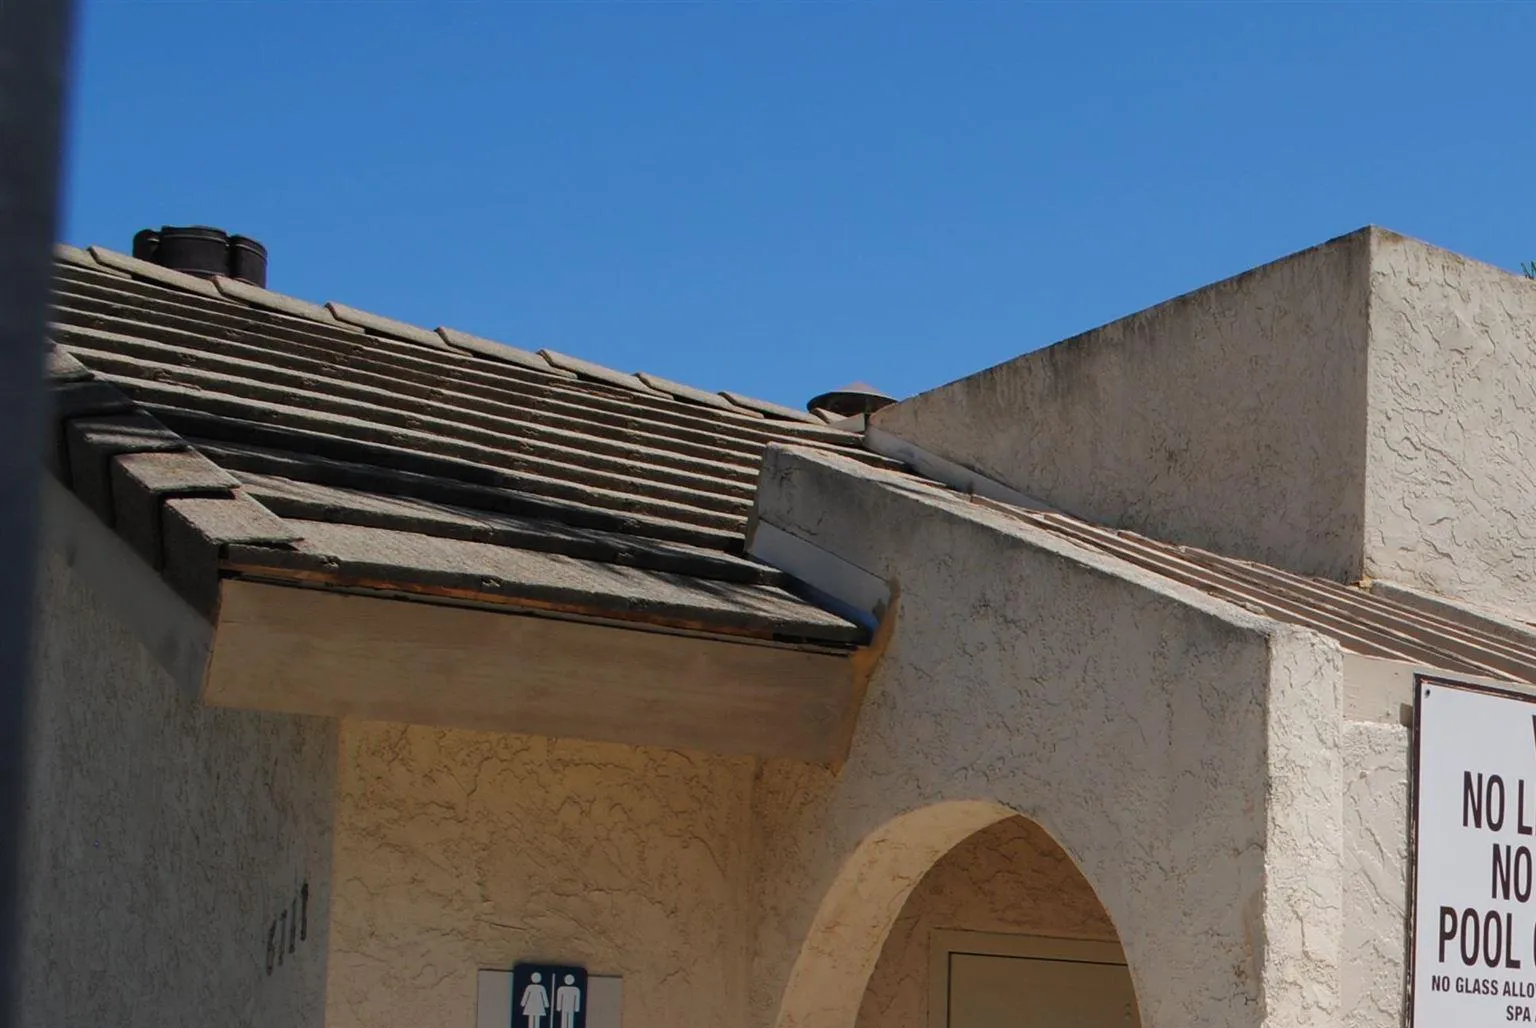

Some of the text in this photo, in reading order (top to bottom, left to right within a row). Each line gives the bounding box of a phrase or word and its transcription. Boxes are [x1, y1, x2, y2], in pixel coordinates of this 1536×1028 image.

[1463, 769, 1504, 832] NO
[1492, 842, 1532, 903] NO
[1439, 905, 1521, 970] POOL
[1432, 974, 1449, 992] NO
[1455, 976, 1498, 995] GLASS
[1506, 1005, 1530, 1022] SPA
